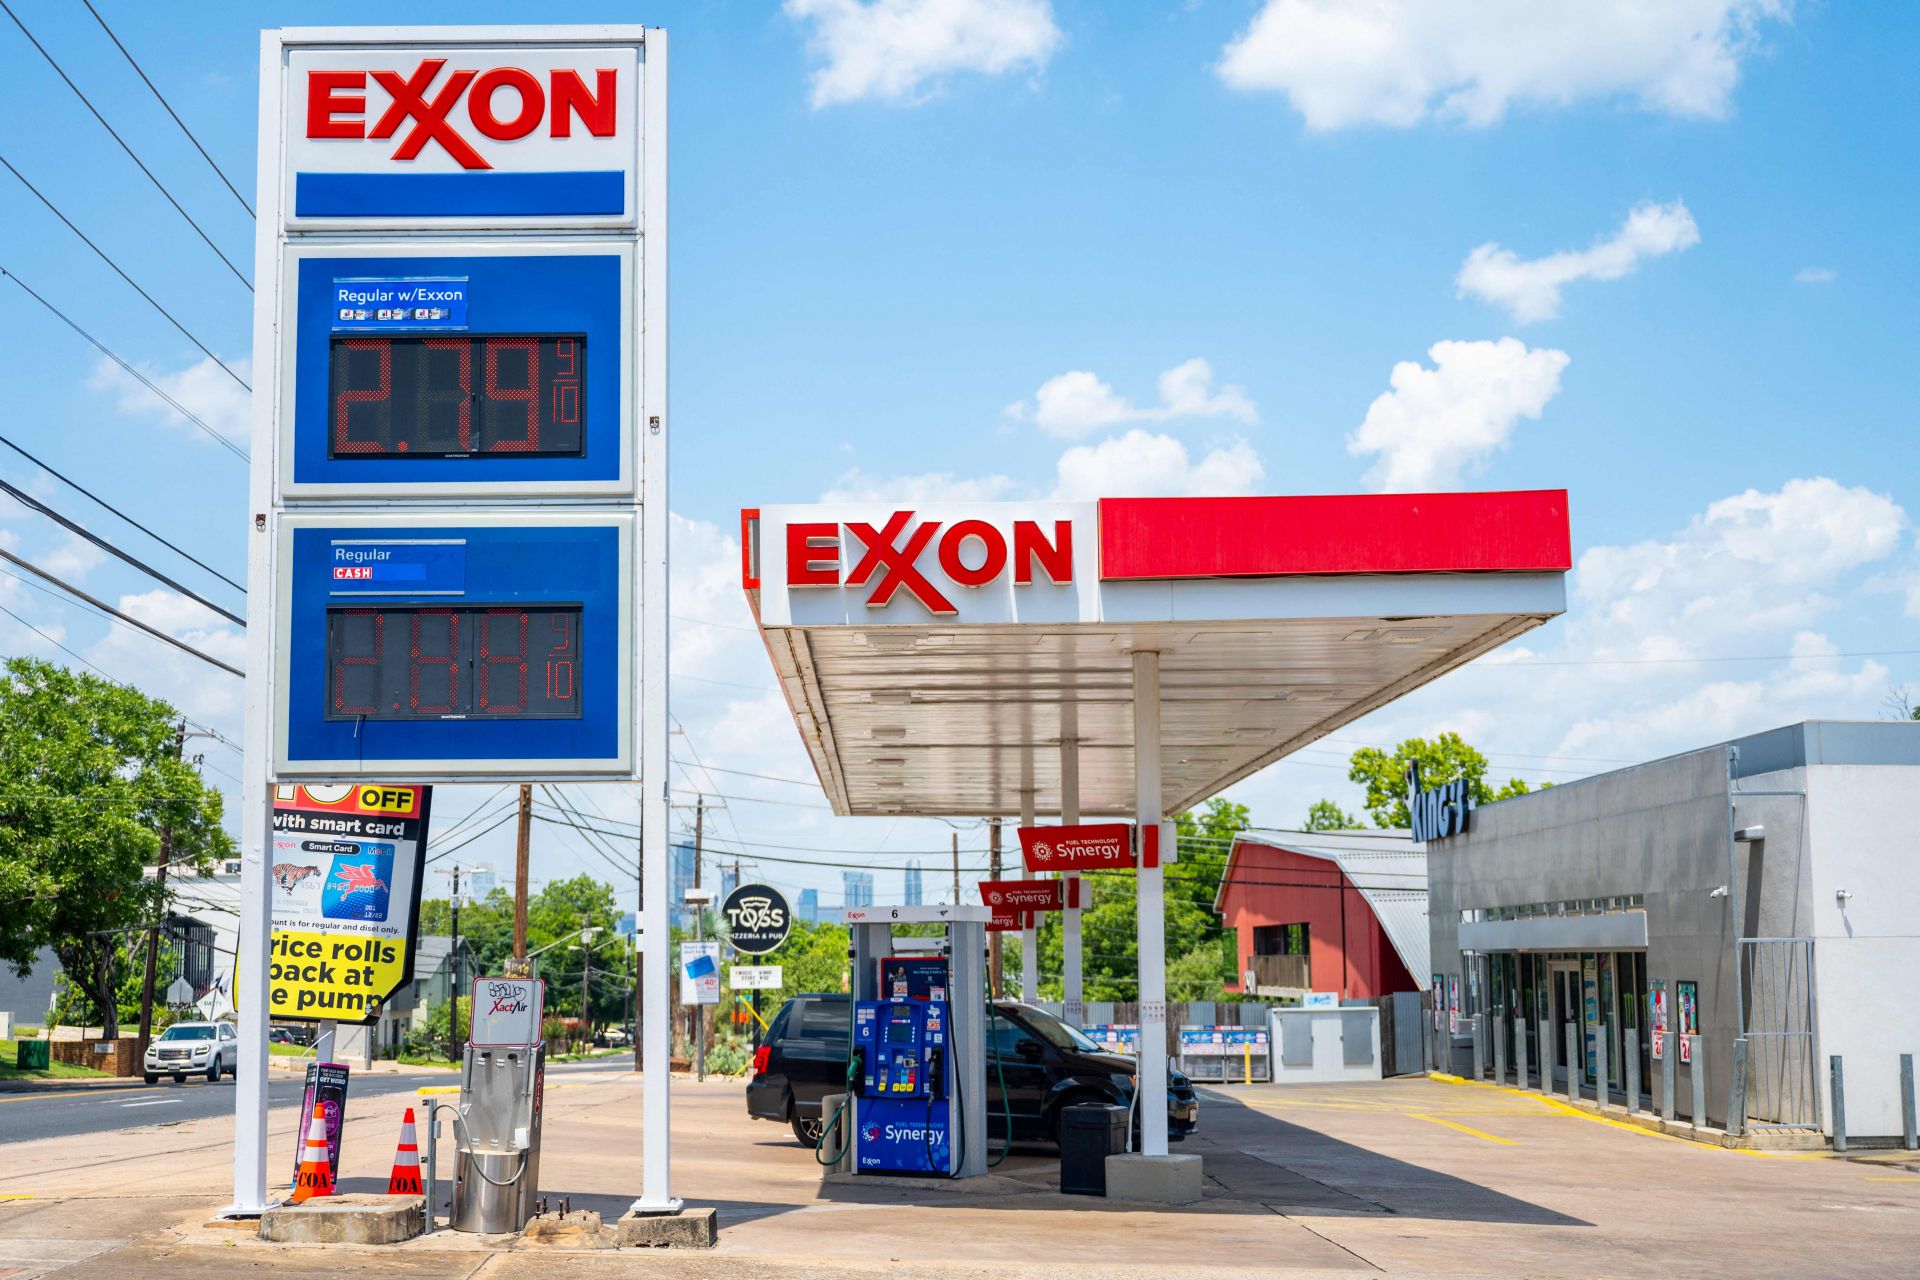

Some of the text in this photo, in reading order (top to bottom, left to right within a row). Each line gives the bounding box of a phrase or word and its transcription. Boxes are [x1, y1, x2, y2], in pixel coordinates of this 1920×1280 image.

[306, 58, 618, 169] EXXON
[338, 287, 463, 305] Regular w/Exxon
[335, 548, 391, 563] Regular
[786, 510, 1073, 616] EXXON
[336, 568, 371, 578] CASH
[362, 790, 412, 808] OFF
[310, 818, 361, 833] smart
[366, 822, 405, 836] card
[308, 843, 353, 853] Smart Card
[1056, 843, 1120, 860] Synergy
[1005, 892, 1051, 905] Synergy
[727, 908, 784, 928] TOSS
[891, 909, 898, 919] 6
[342, 923, 358, 931] and
[360, 923, 379, 932] disel
[381, 926, 400, 934] only.
[271, 934, 396, 964] rice rolls
[343, 968, 374, 987] at
[488, 998, 528, 1015] XactAir
[862, 1027, 870, 1036] 6
[885, 1125, 944, 1145] Synergy
[862, 1157, 880, 1166] Exxon
[298, 1172, 328, 1188] COA
[389, 1177, 418, 1193] COA
